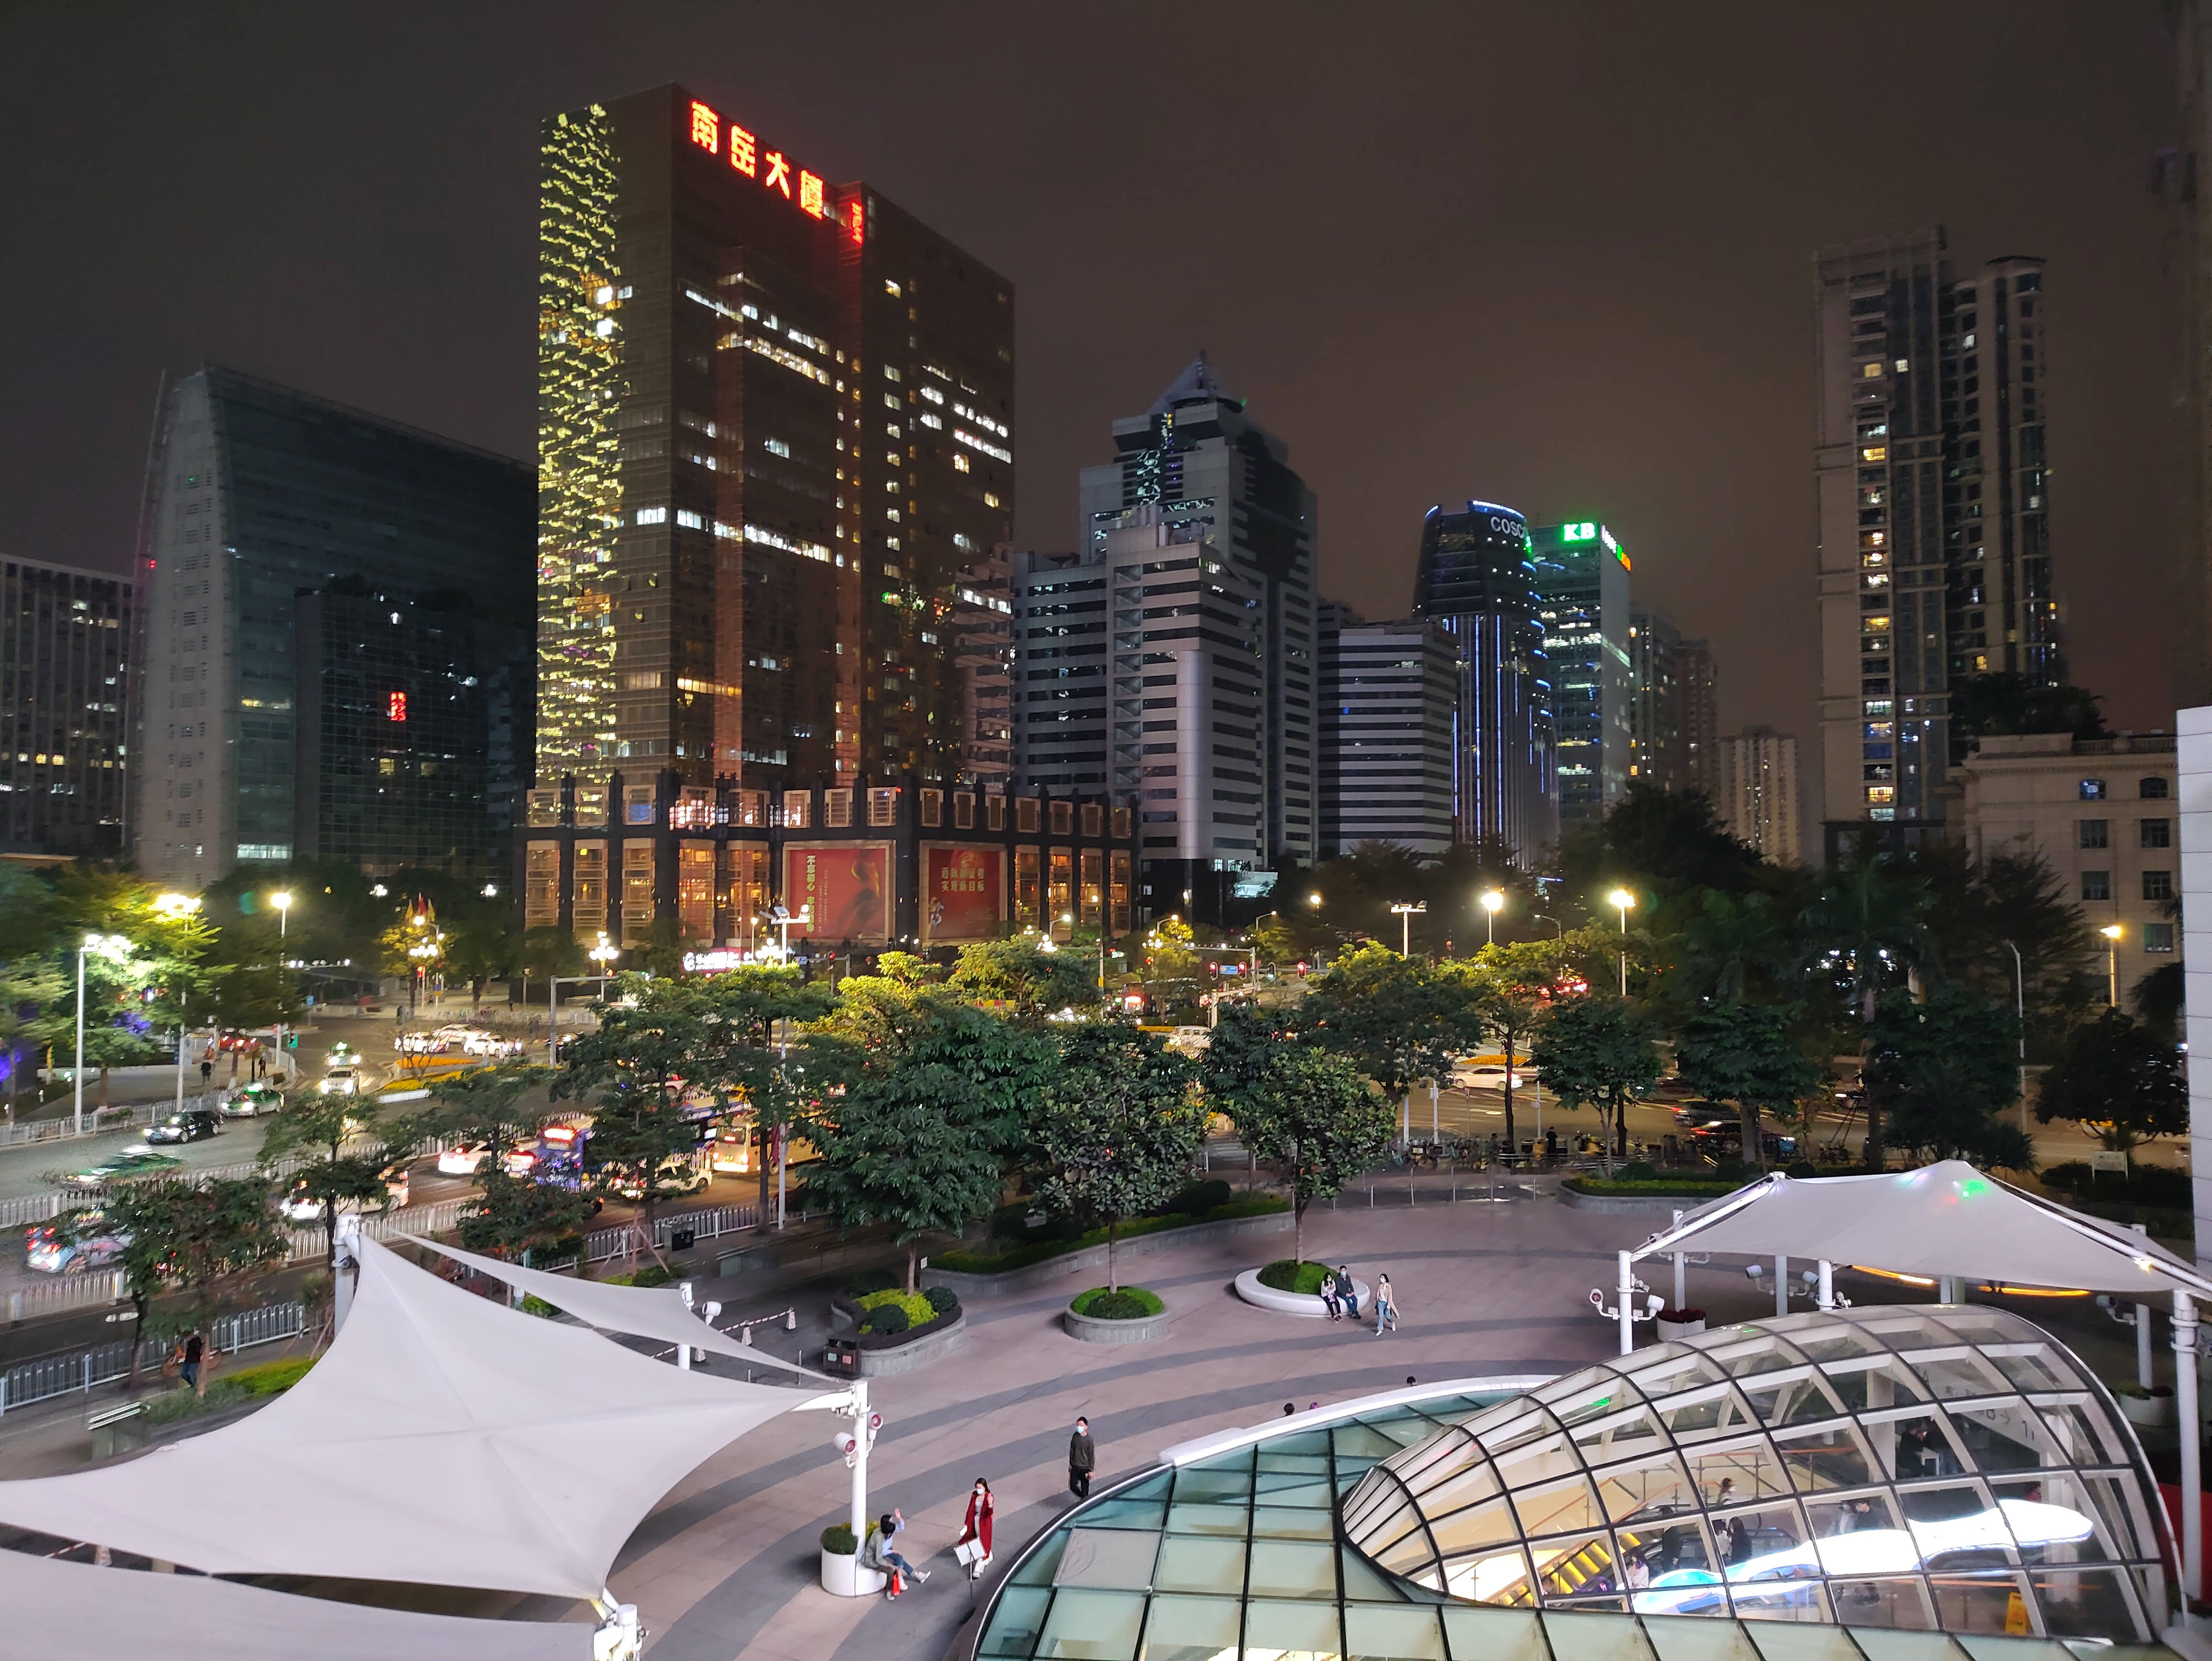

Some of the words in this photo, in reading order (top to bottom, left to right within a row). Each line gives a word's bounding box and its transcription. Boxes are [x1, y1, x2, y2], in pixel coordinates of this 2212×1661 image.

[691, 100, 824, 221] 南岳大厦
[1563, 522, 1596, 541] KB
